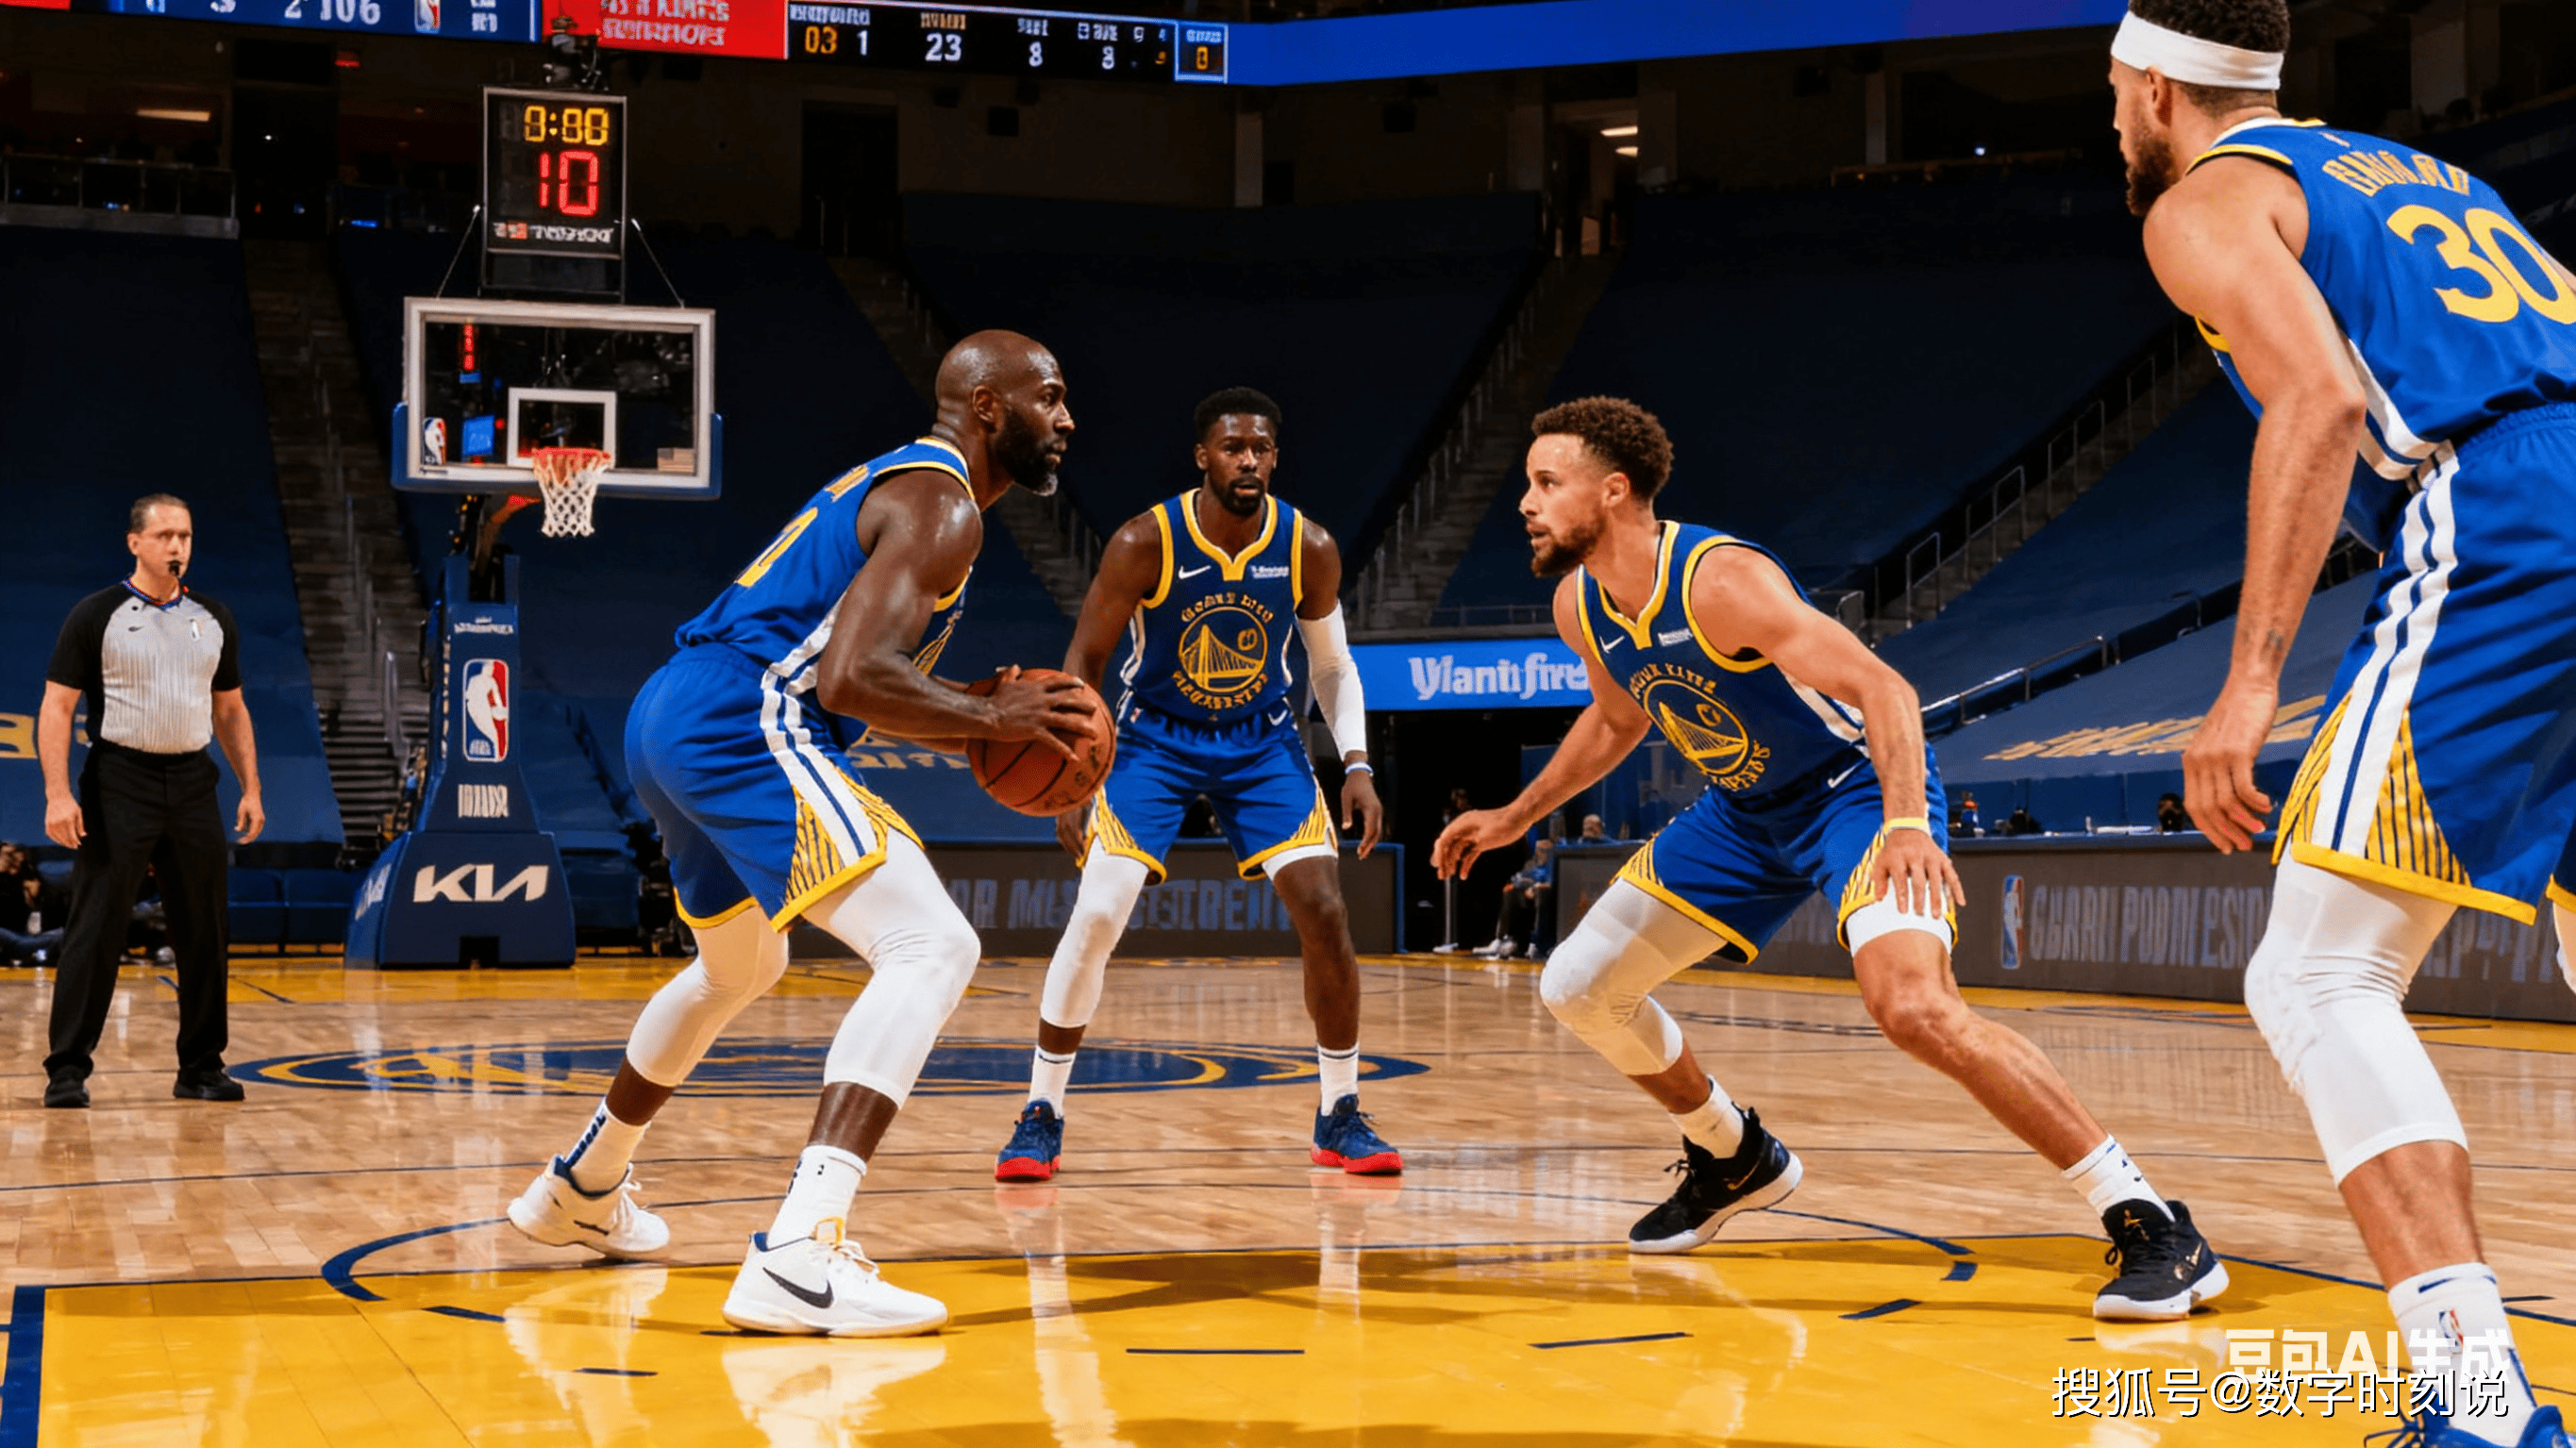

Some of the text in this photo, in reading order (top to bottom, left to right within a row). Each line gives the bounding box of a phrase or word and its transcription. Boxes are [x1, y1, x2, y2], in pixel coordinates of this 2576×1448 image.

[925, 33, 962, 61] 23
[540, 150, 598, 217] 10
[2386, 205, 2576, 325] 30
[413, 863, 549, 903] KIA
